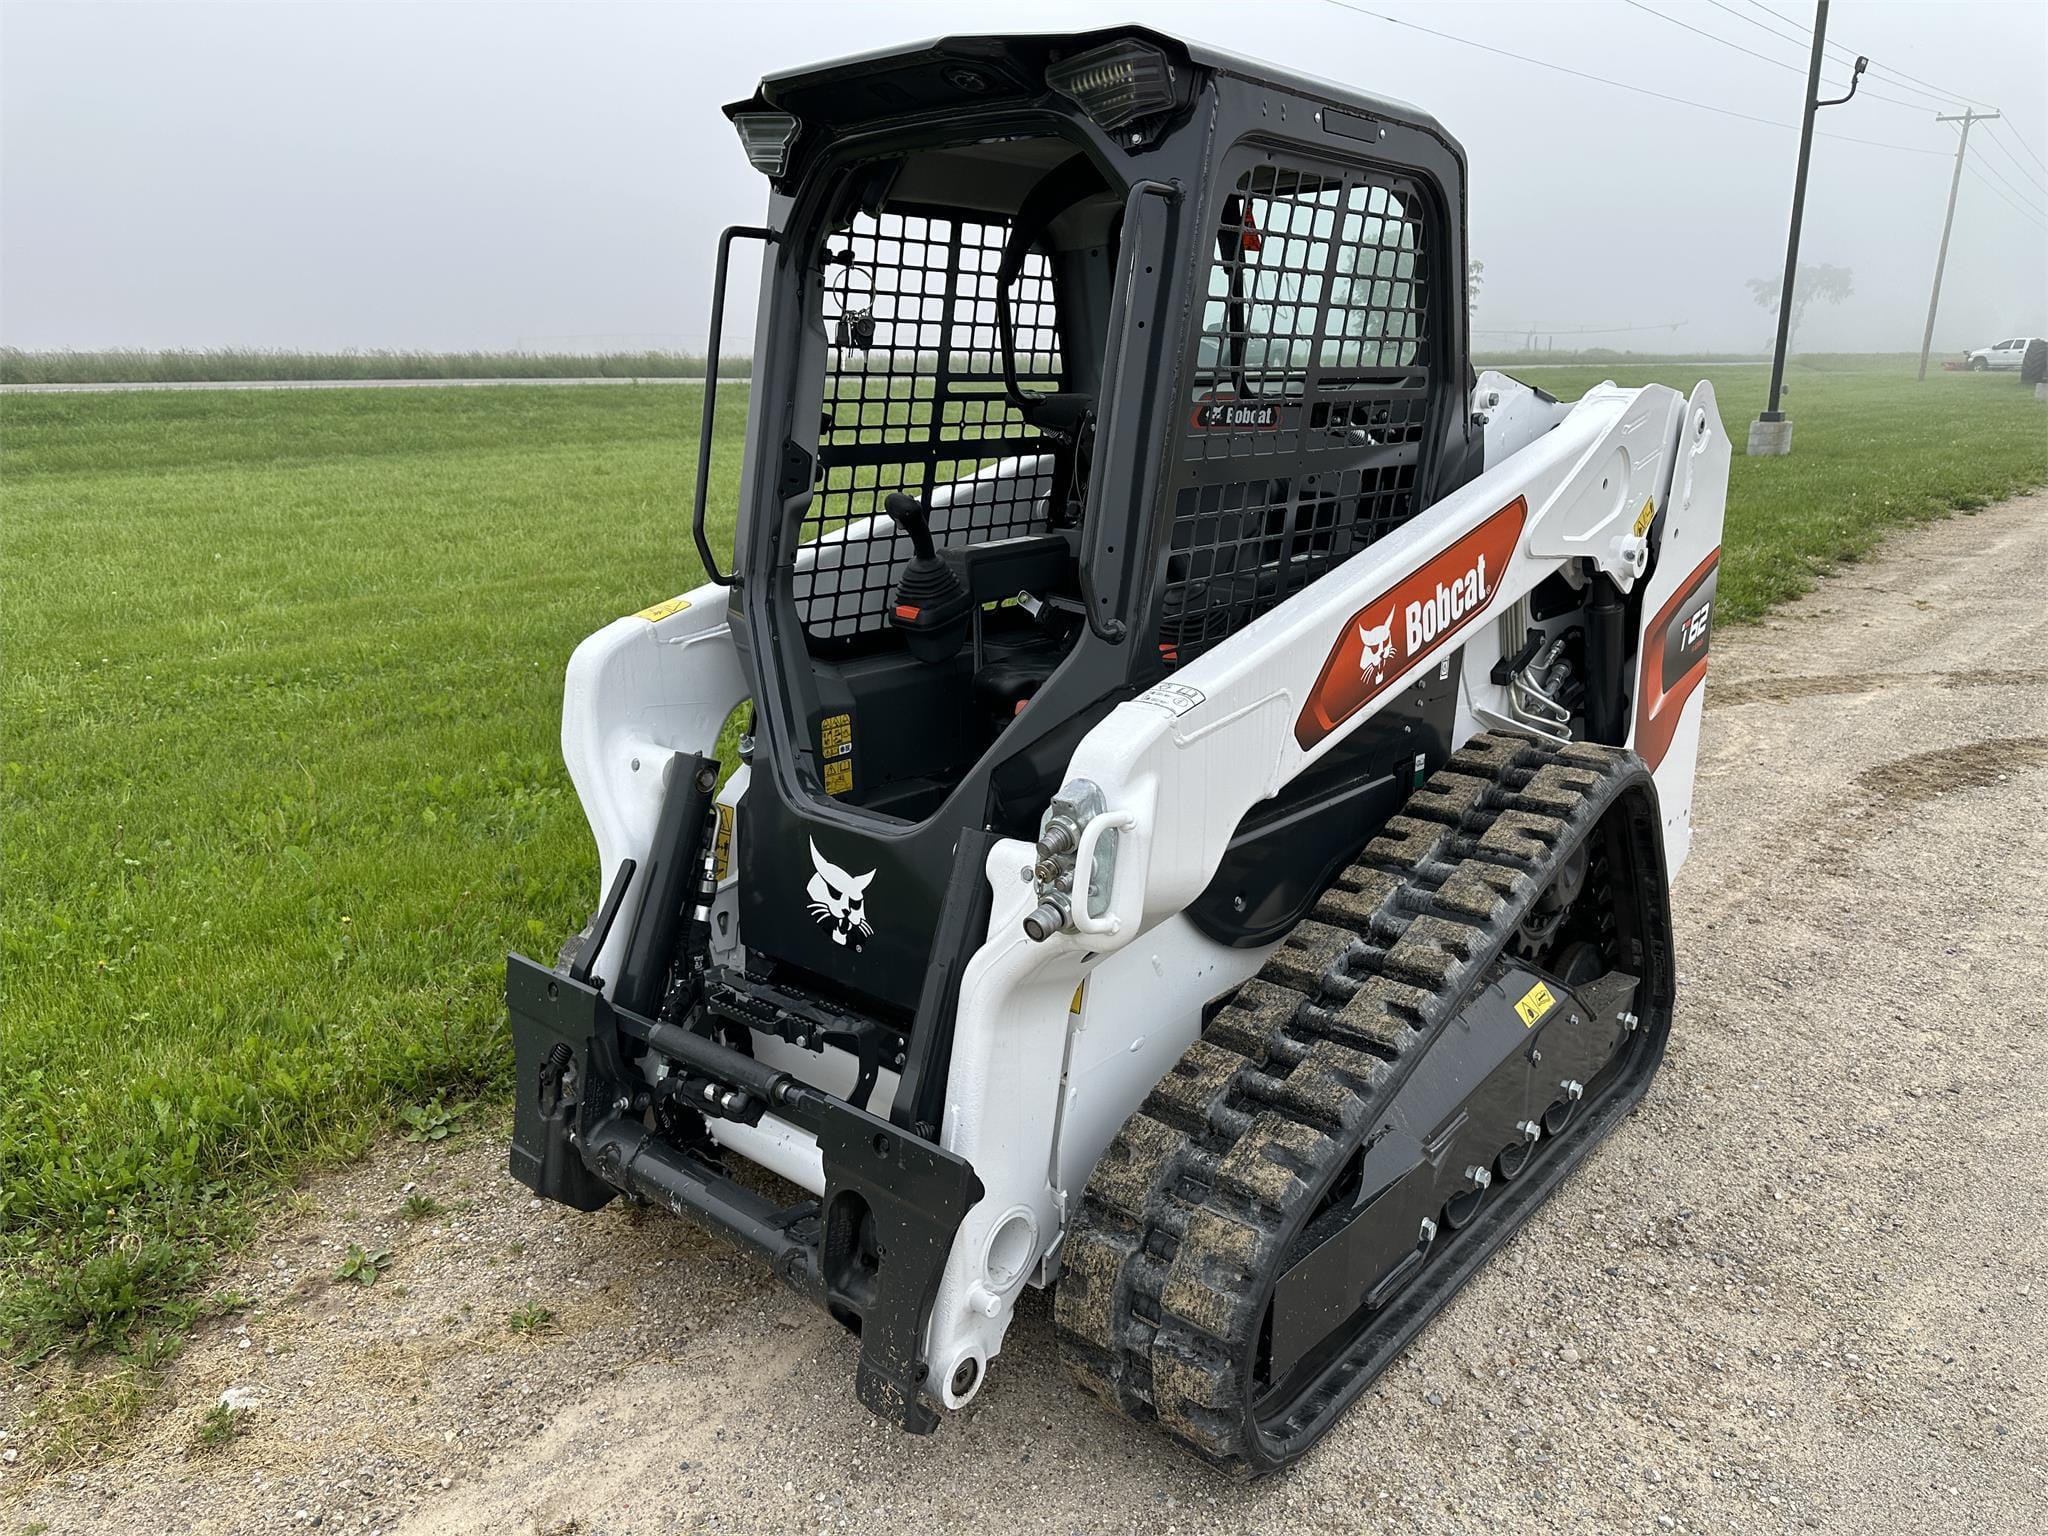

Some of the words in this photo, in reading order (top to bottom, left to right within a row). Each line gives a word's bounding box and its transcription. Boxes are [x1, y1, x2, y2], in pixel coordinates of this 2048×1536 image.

[1226, 407, 1272, 424] Bobcat
[1405, 553, 1486, 657] Bobcat
[1680, 602, 1710, 652] T62
